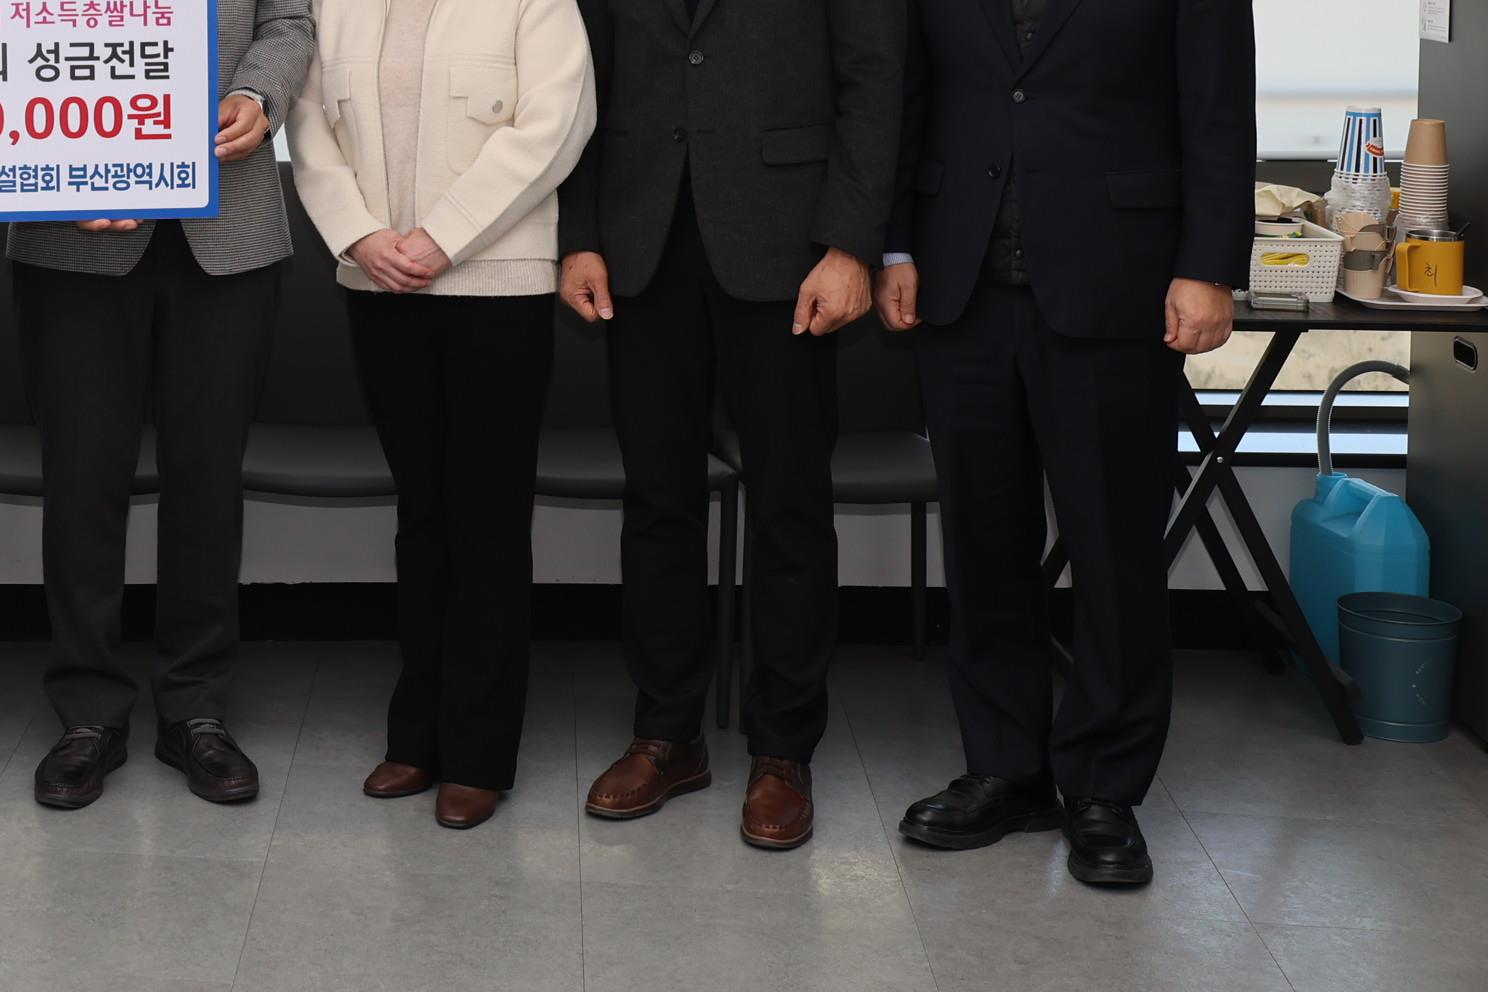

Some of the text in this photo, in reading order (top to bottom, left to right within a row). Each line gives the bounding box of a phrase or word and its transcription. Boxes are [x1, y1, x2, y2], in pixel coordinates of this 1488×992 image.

[10, 0, 174, 29] 저소득층쌀나눔
[27, 40, 175, 83] 성금전달
[67, 162, 197, 193] 부산광역시회
